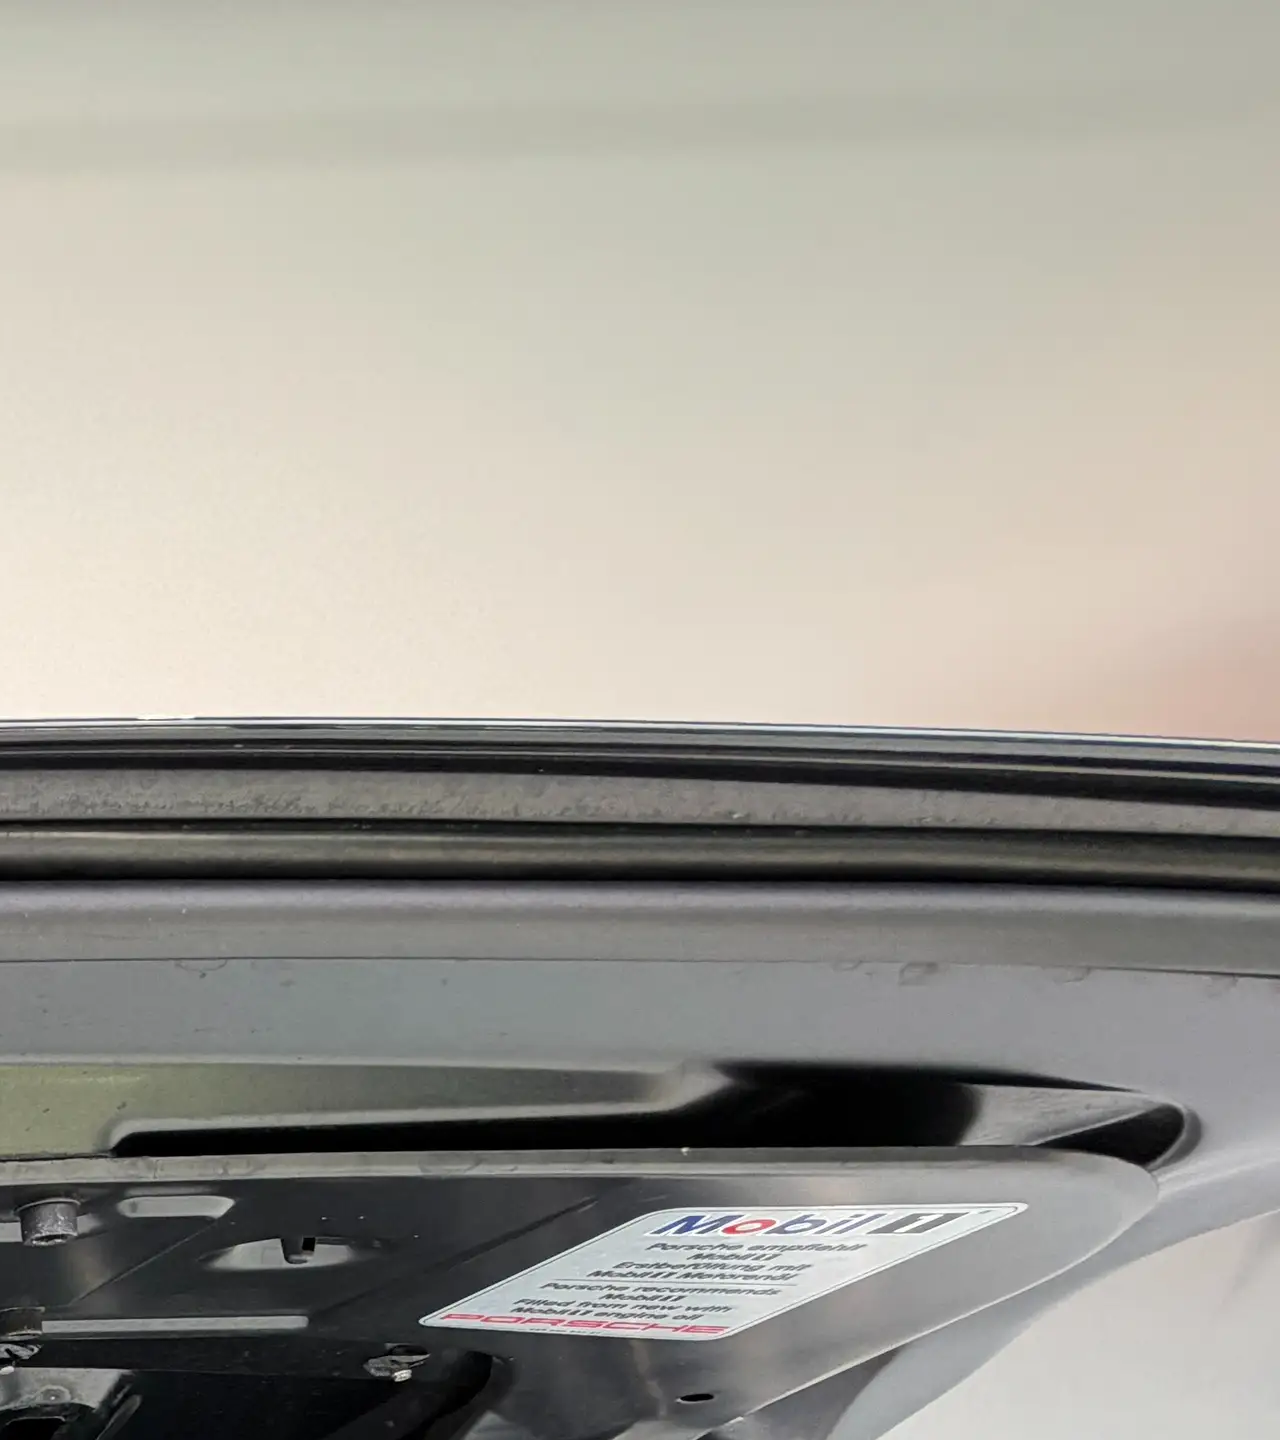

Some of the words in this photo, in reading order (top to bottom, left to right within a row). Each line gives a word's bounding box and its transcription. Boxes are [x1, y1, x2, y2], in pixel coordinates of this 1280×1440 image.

[649, 1212, 889, 1235] Mobil
[645, 1242, 744, 1251] Porsche
[687, 1252, 756, 1262] Mobil
[768, 1263, 814, 1271] mit
[586, 1270, 654, 1279] Mobil
[539, 1282, 634, 1292] Porsche
[632, 1286, 783, 1296] recommends
[598, 1292, 664, 1302] Mobil
[512, 1297, 577, 1307] Filled
[576, 1300, 629, 1309] from
[629, 1303, 684, 1311] new
[684, 1304, 733, 1313] with
[509, 1306, 574, 1316] Mobil
[593, 1311, 670, 1321] engine
[671, 1313, 705, 1321] oil
[440, 1312, 731, 1335] PORSCHE
